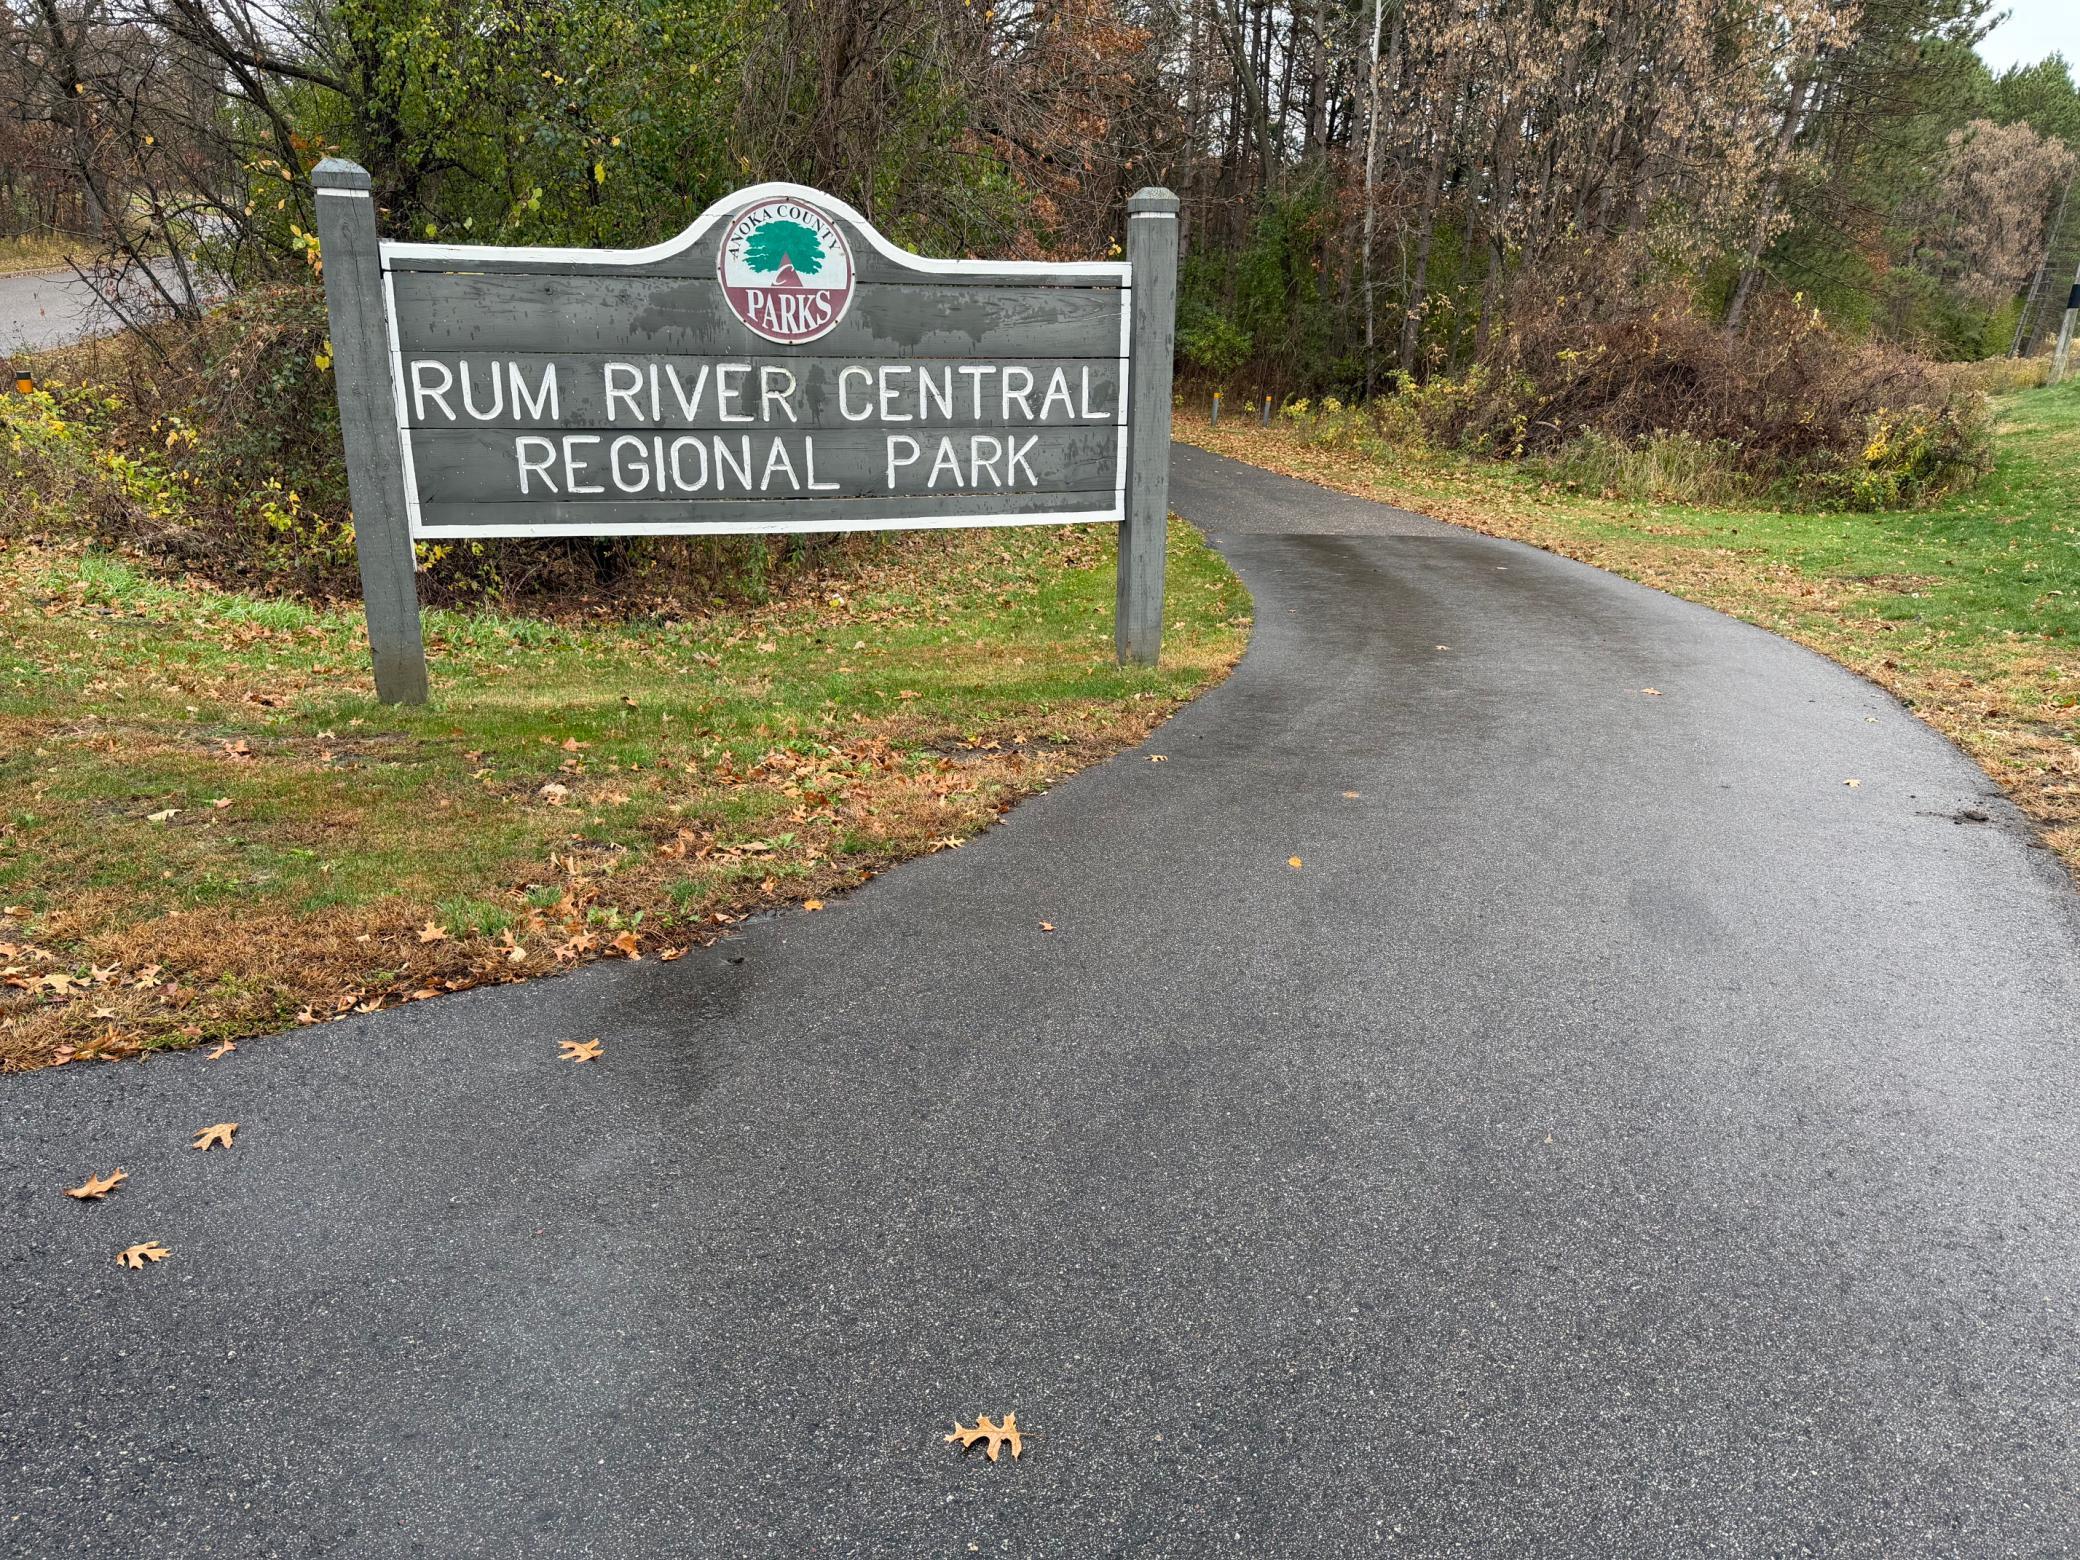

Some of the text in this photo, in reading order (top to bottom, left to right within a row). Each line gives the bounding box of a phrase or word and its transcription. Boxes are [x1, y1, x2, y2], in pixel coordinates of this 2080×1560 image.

[728, 204, 841, 262] ANOKA COUNTY
[745, 288, 833, 334] PARKS
[410, 360, 1112, 422] RUM RIVER CENTRAL
[515, 434, 1039, 494] REGIONAL PARK
